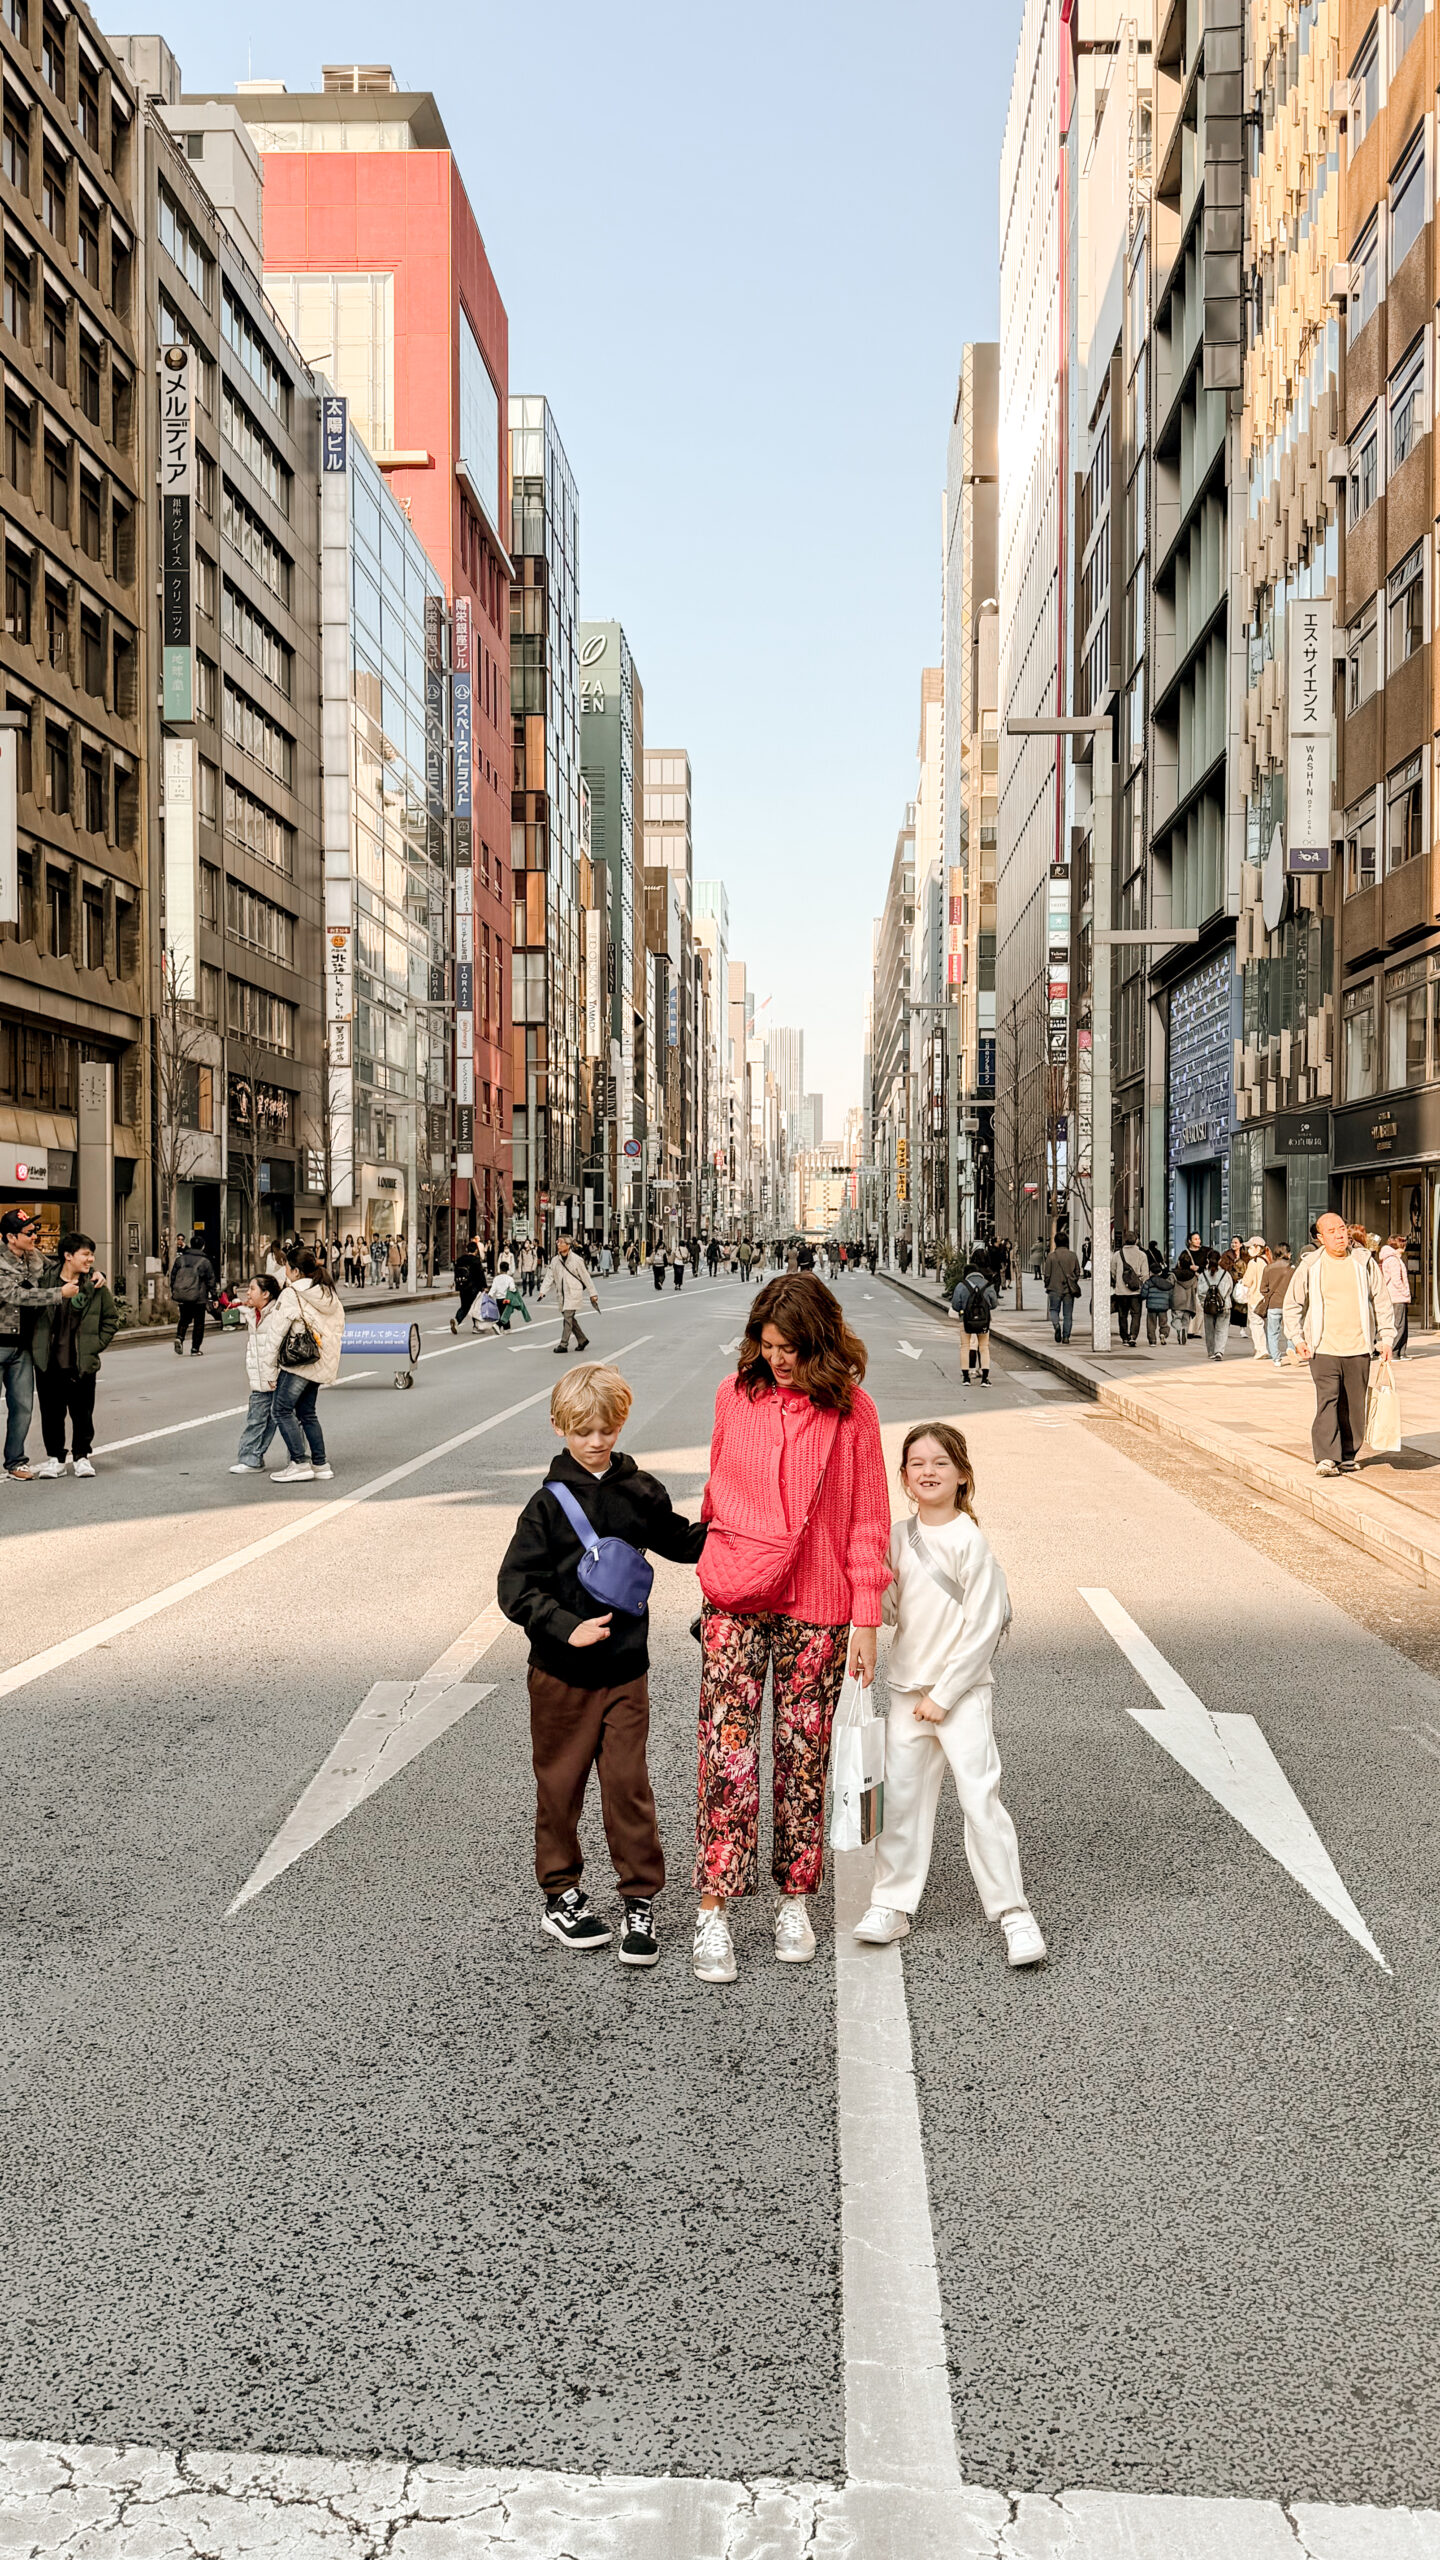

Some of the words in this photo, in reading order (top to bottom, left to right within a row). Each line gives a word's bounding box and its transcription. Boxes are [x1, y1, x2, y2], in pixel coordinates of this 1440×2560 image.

[165, 373, 187, 484] メルディア
[326, 398, 343, 470] 太陽ビル
[171, 578, 182, 639] クリニック
[455, 598, 469, 669] 陽栄銀座ビル
[1303, 613, 1318, 722] エス・サイエンス
[456, 703, 470, 806] スペーストラスト
[1305, 745, 1315, 796] WASHIN
[458, 840, 470, 856] AK
[588, 1000, 597, 1034] YAMADA
